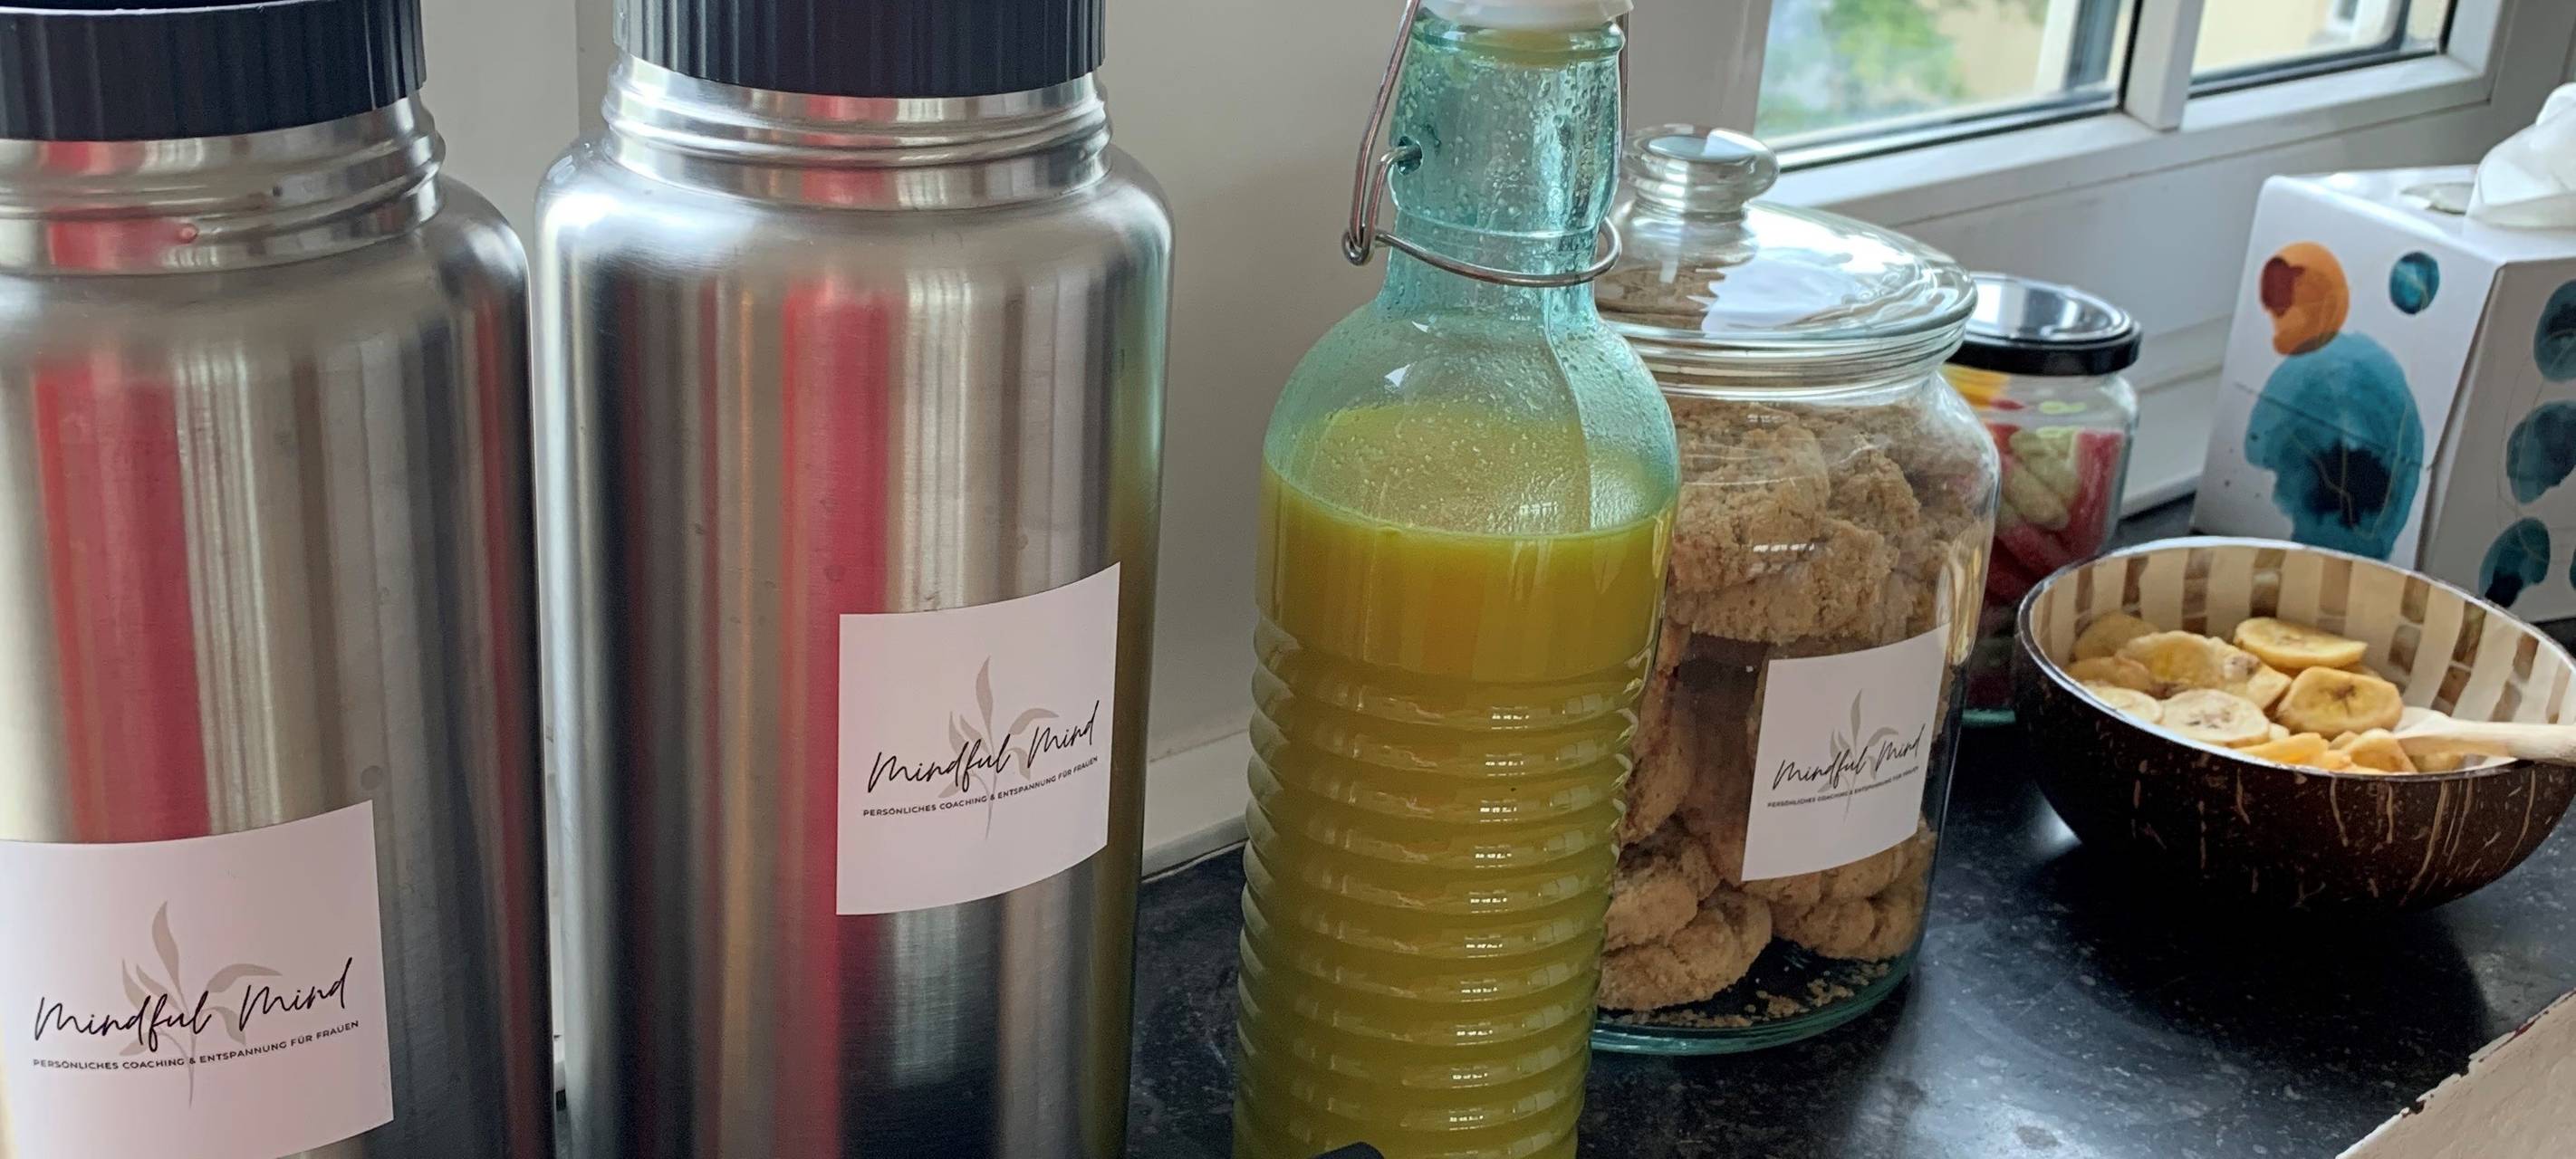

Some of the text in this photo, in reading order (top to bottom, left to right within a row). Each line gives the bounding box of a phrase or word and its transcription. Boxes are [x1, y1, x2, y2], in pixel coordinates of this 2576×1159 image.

[867, 700, 1100, 793] Mindful Mind
[1772, 723, 1926, 790] Mindful Mind
[862, 755, 1099, 817] PERSÖNLICHES COACHING & ENTSPANNUNG FÜR FRAUEN
[1767, 797, 1816, 807] PERSÖNLICHES
[34, 957, 353, 1052] Mindful Mind
[33, 1020, 360, 1070] PERSÖNLICHES COACHING & ENTSPANNUNG FÜR FRAUEN
